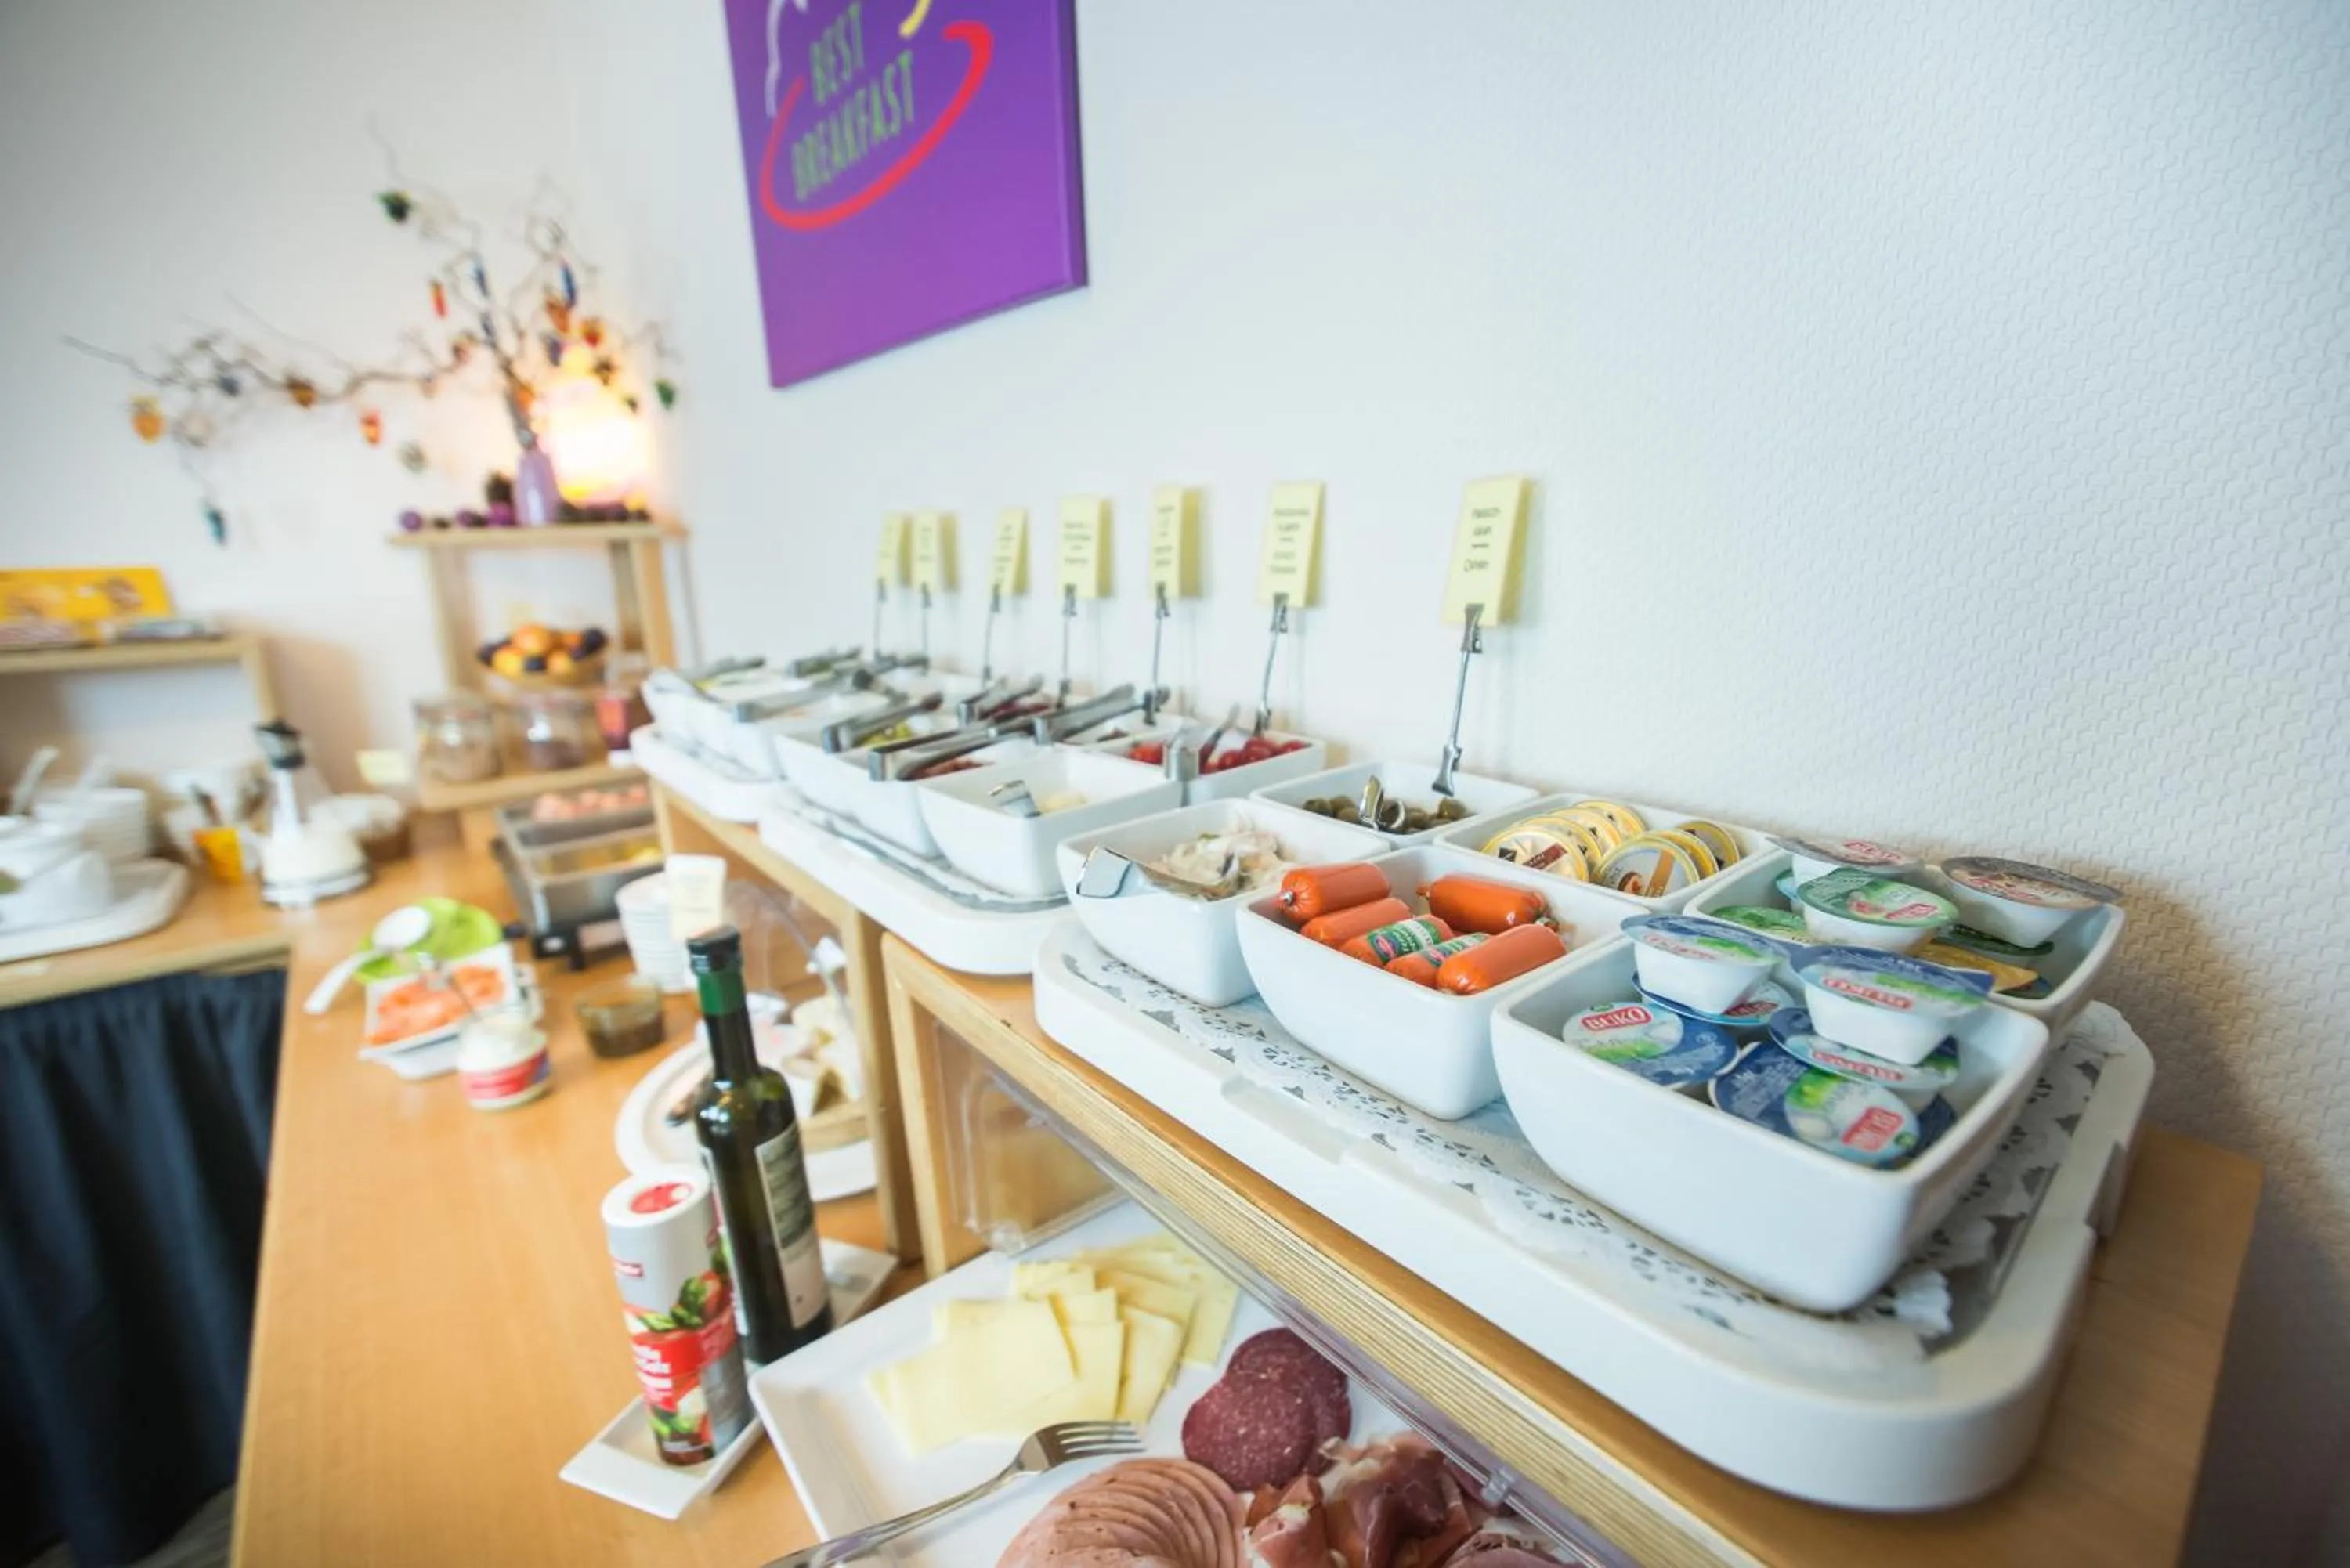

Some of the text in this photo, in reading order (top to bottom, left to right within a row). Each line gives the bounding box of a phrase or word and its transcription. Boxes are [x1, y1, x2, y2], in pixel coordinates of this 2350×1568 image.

[810, 2, 865, 104] BEST
[791, 49, 914, 202] BREAKFAST
[1585, 1006, 1647, 1031] BUKO
